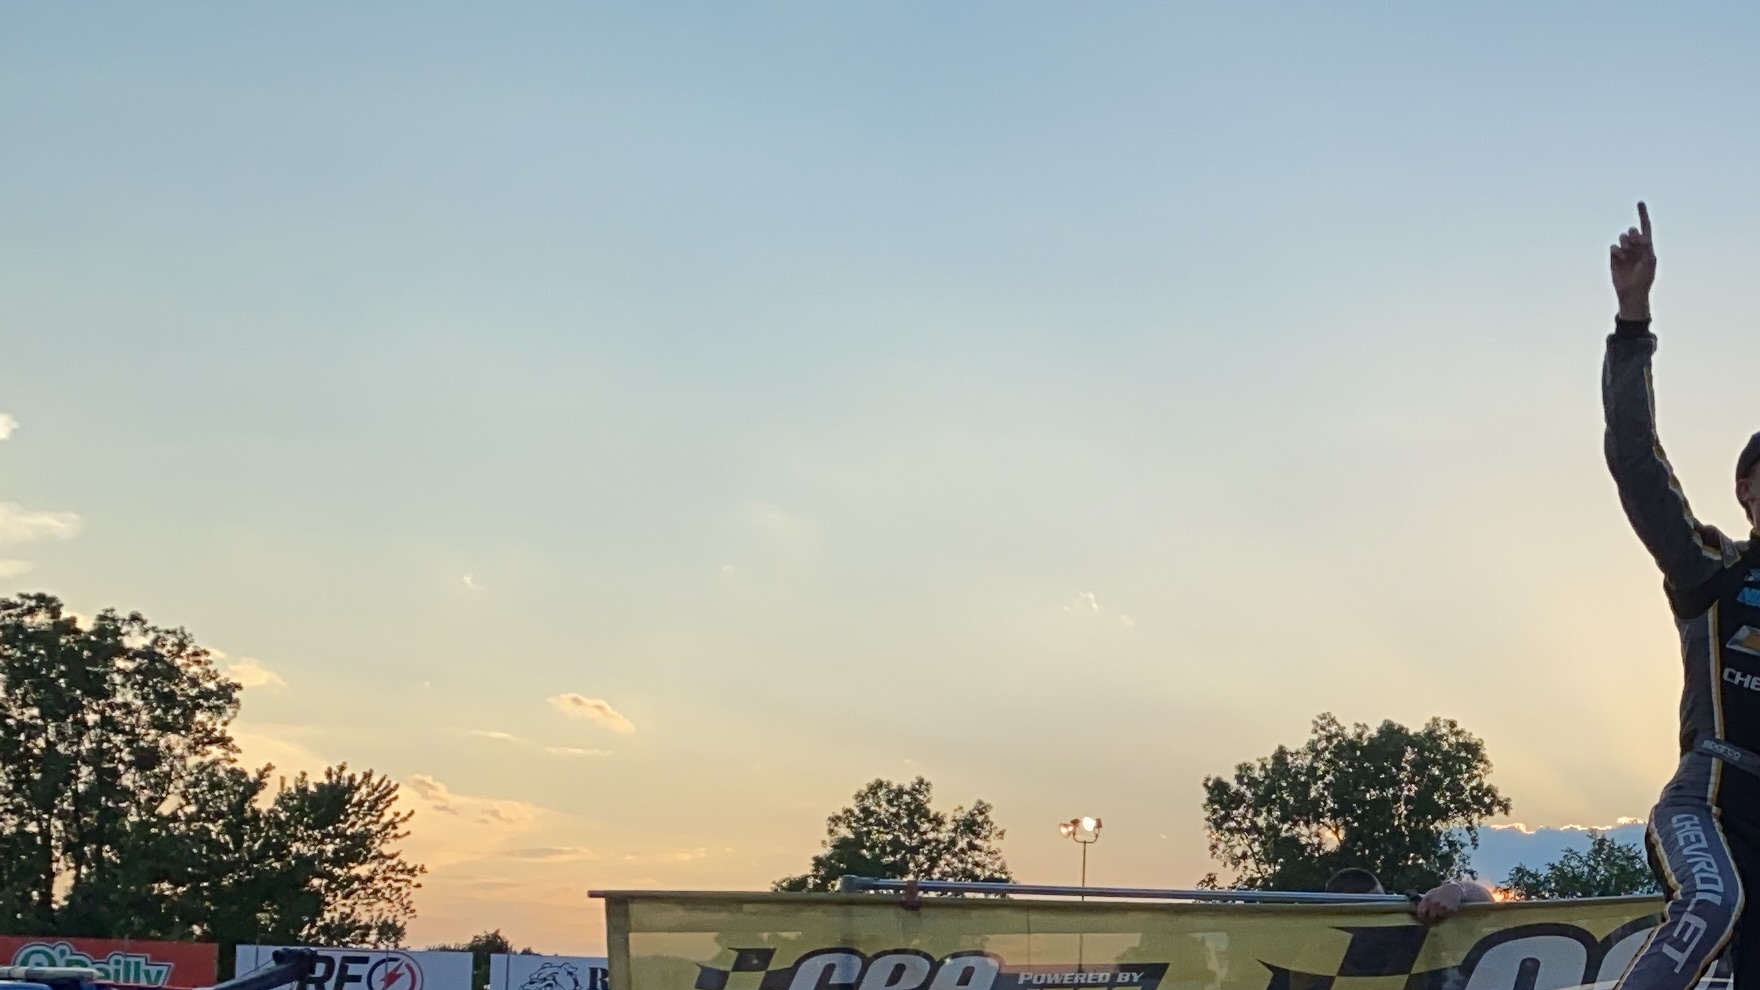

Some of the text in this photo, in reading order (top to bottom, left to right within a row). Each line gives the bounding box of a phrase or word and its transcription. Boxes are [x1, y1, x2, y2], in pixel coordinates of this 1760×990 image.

[1662, 813, 1724, 973] CHEVROLET
[1017, 970, 1144, 985] POWERED BY
